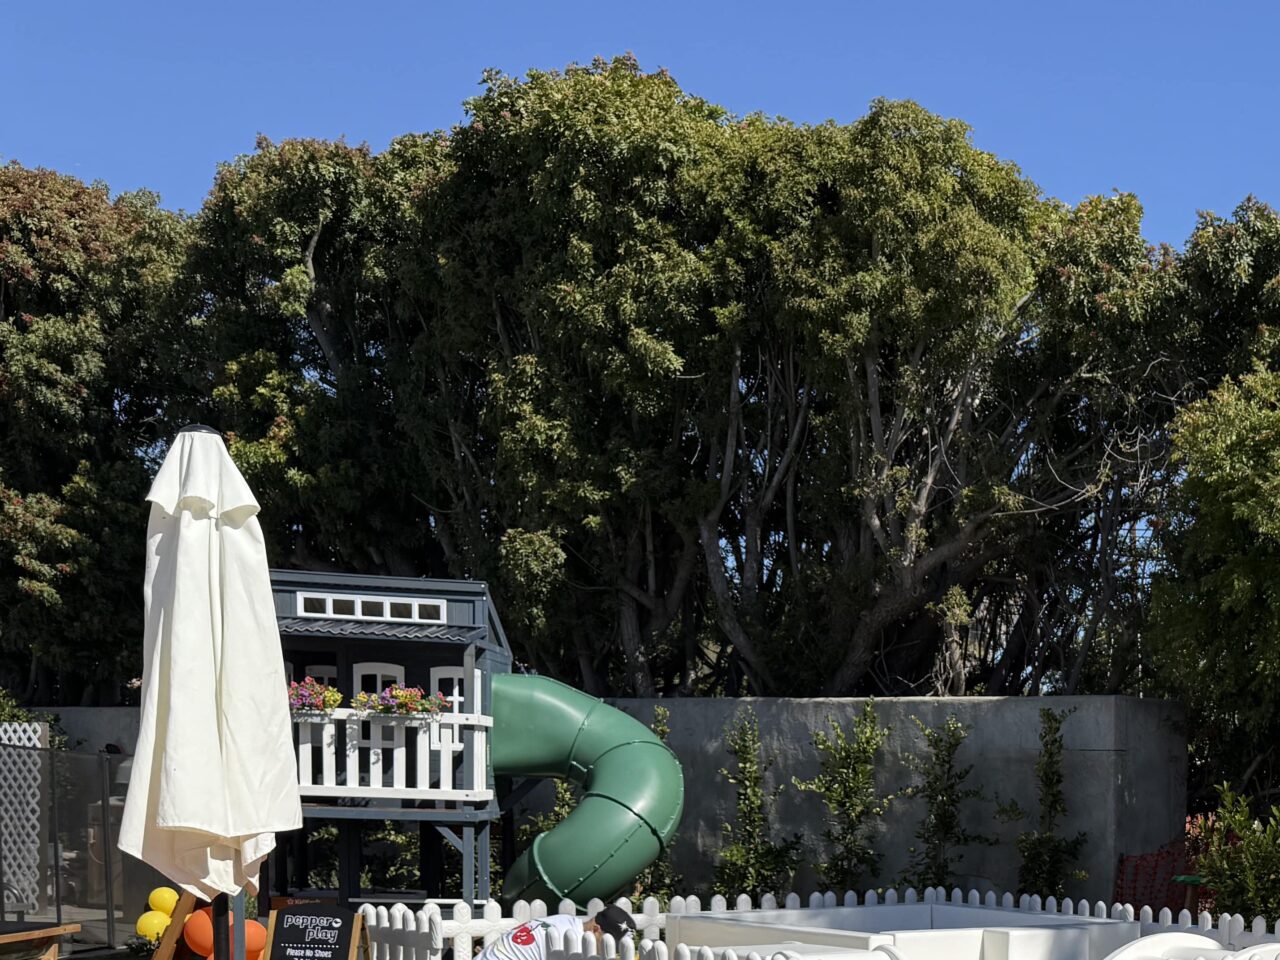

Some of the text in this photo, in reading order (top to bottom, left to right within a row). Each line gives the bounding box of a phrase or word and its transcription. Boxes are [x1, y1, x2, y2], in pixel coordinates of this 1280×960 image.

[284, 914, 333, 929] pepper
[305, 927, 339, 943] play
[286, 948, 332, 958] Please No Shoes
